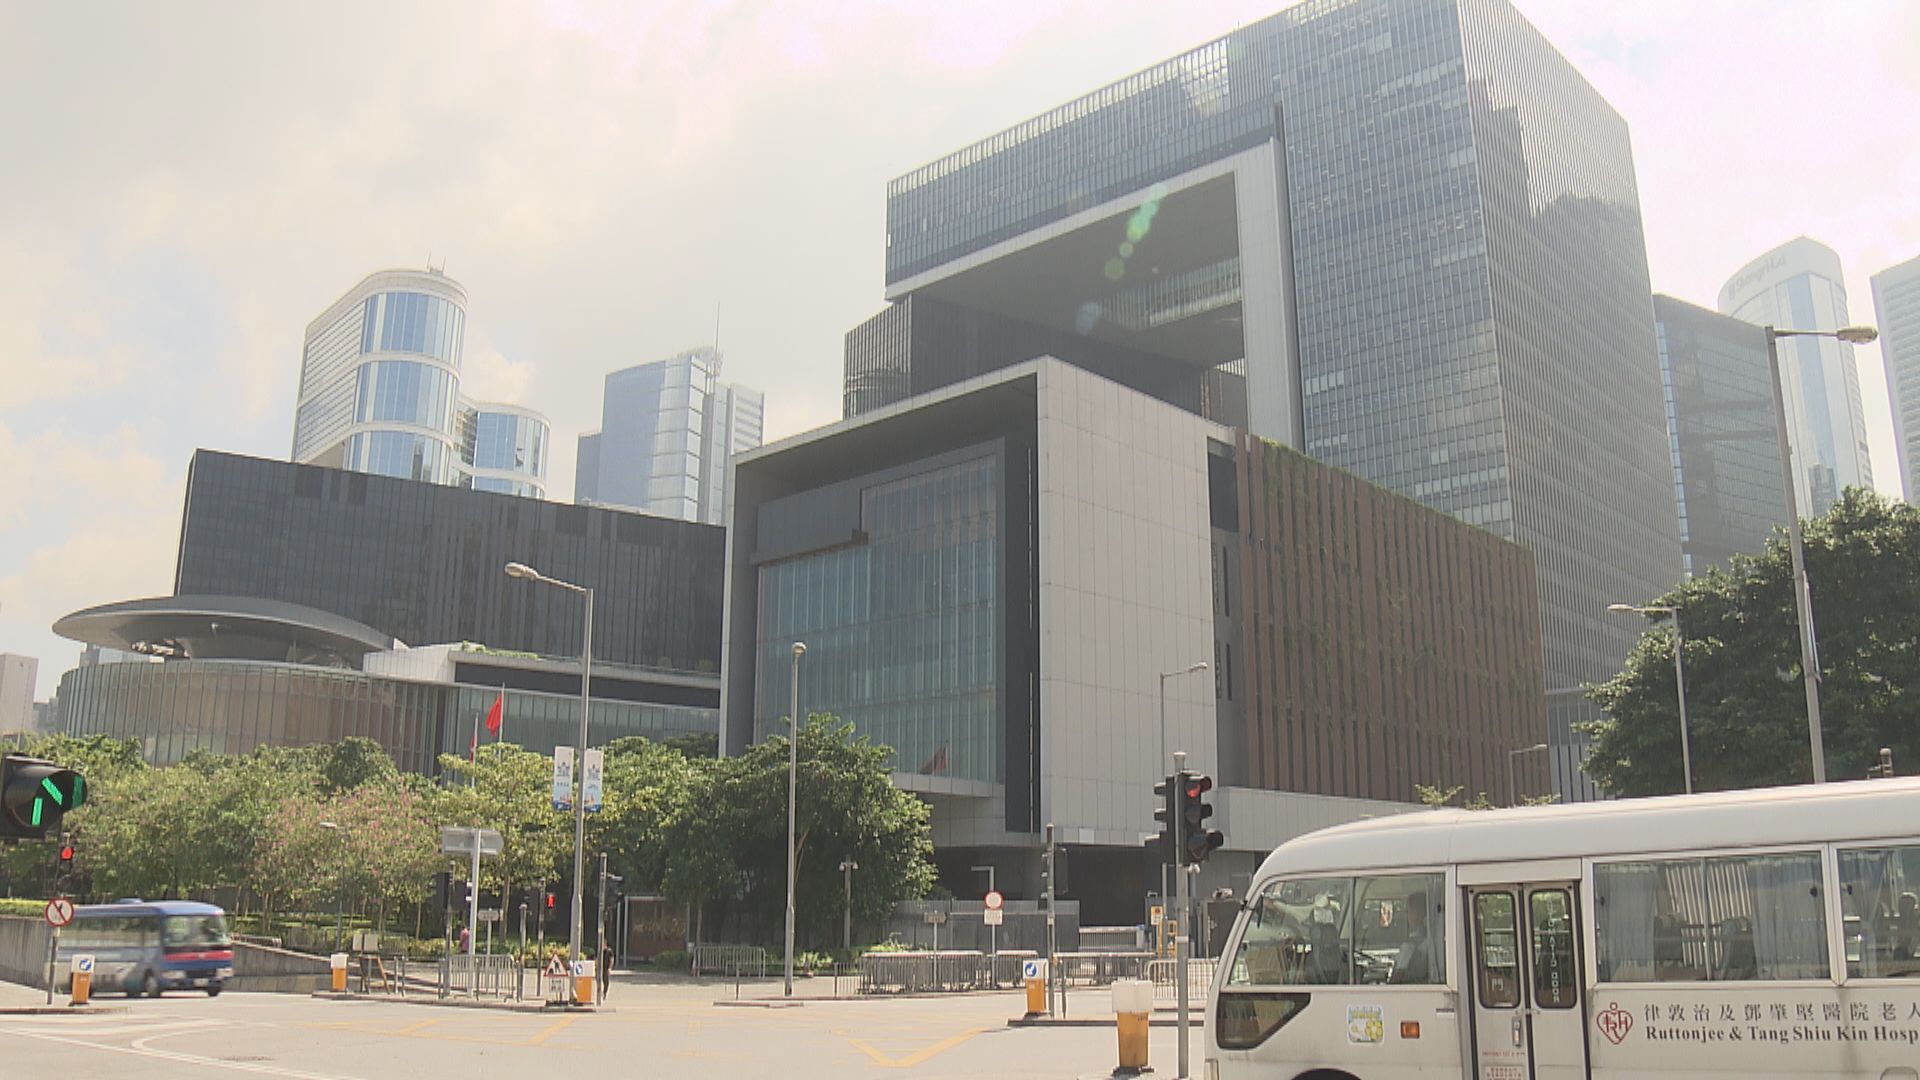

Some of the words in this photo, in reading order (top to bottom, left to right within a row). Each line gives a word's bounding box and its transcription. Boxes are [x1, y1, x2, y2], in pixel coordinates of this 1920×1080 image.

[1646, 1026, 1725, 1043] Ruttonjee
[1729, 1025, 1743, 1038] &
[1747, 1025, 1789, 1044] Tang
[1793, 1025, 1831, 1038] Shiu
[1837, 1025, 1868, 1038] Kin
